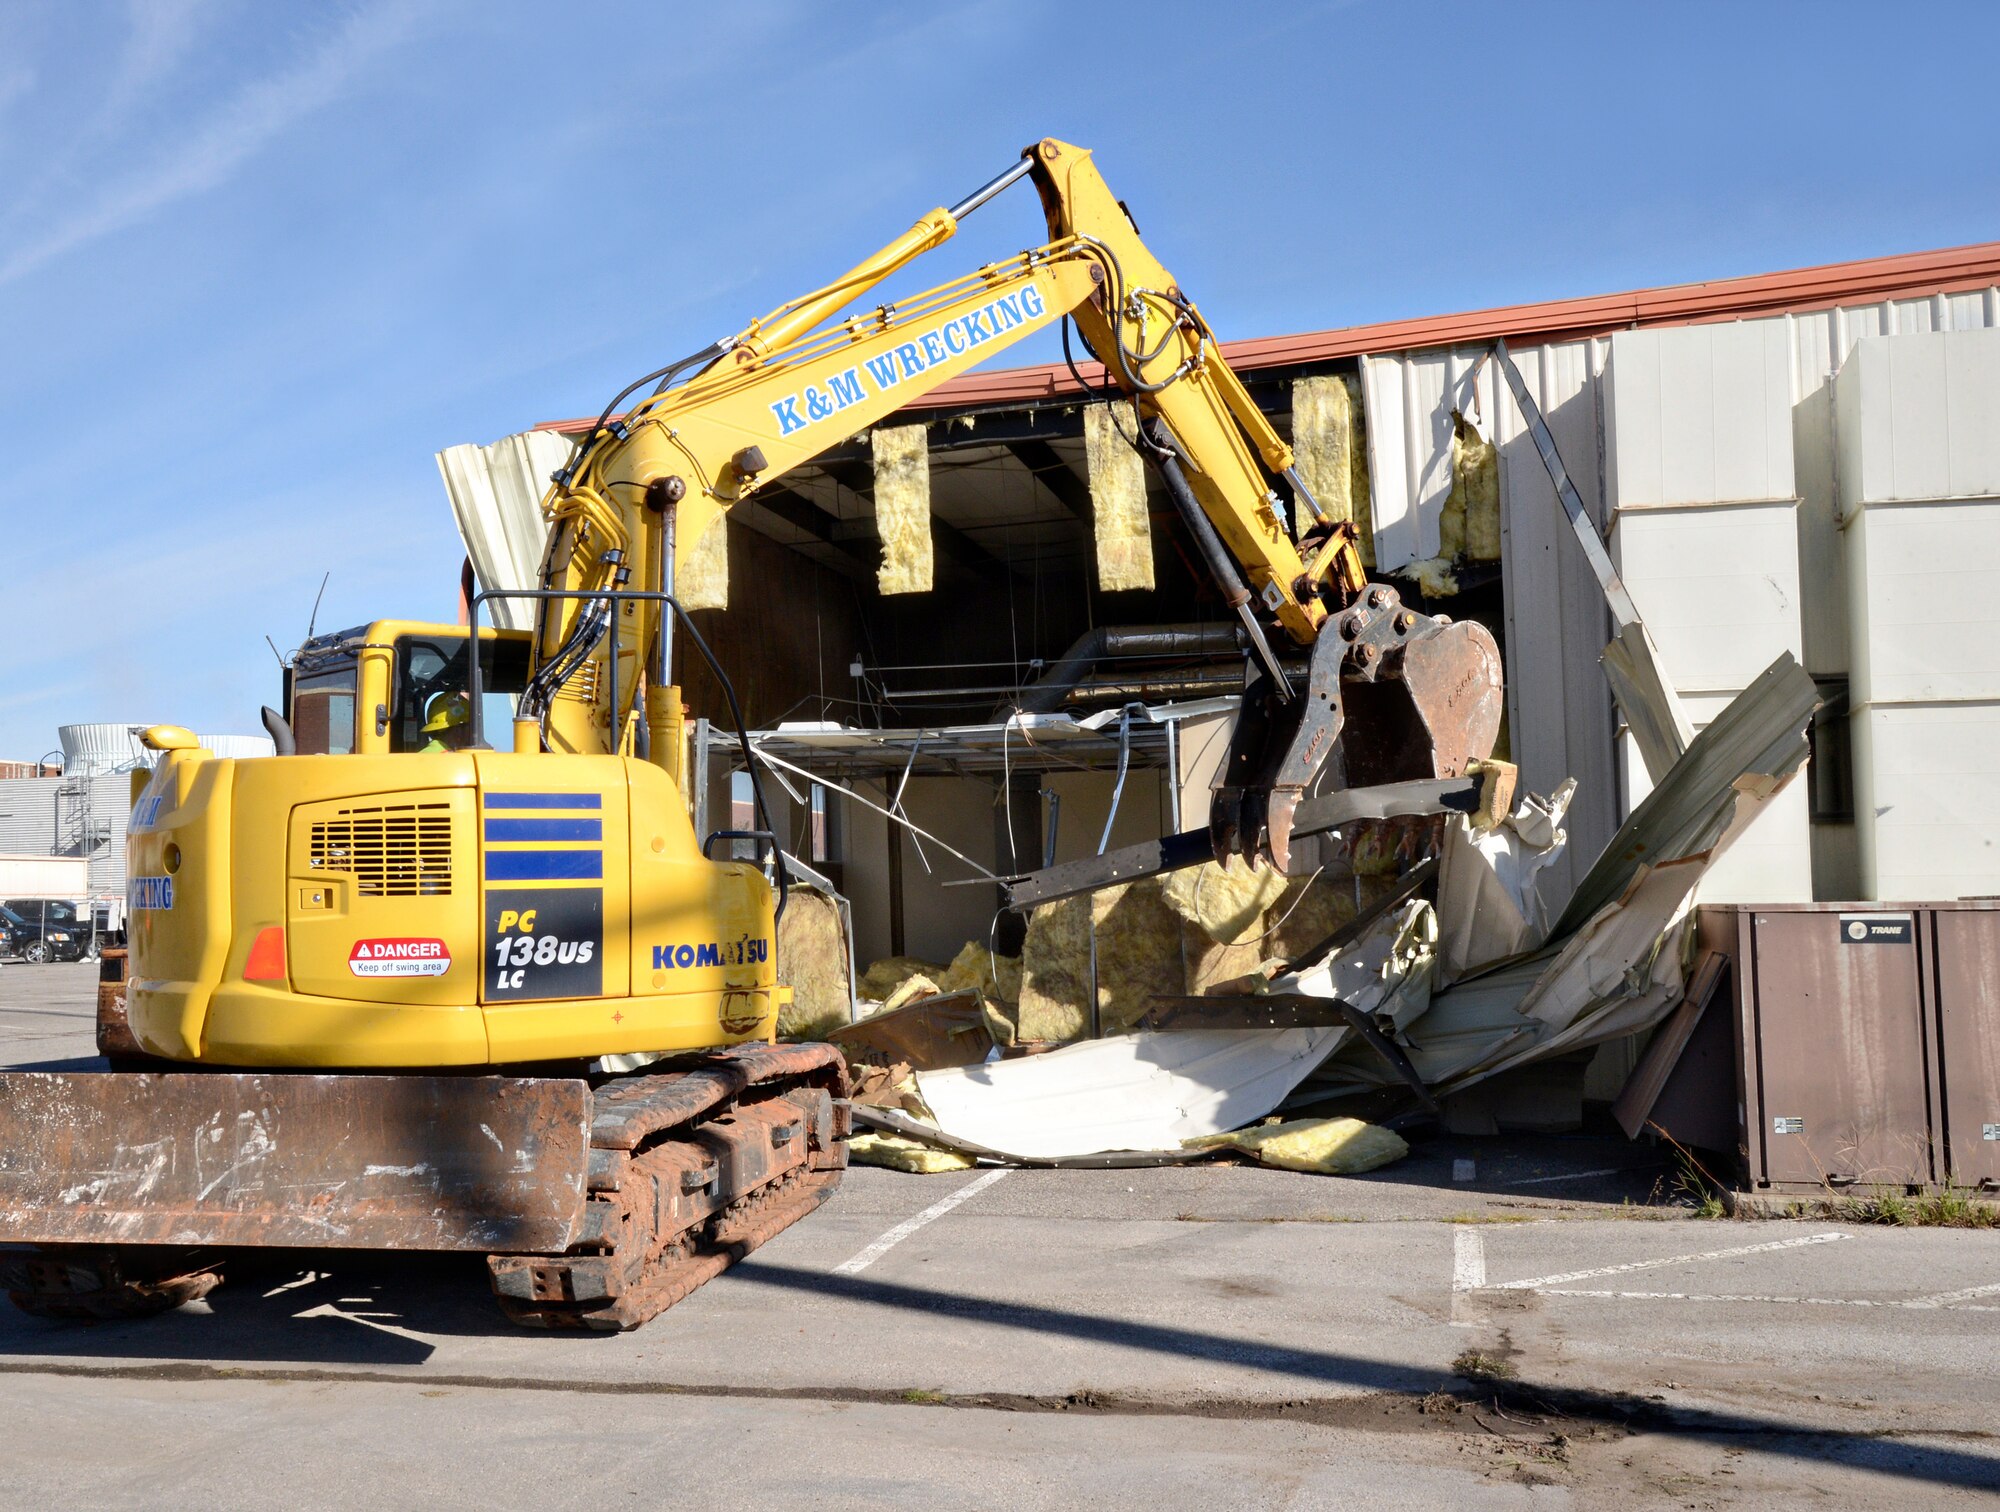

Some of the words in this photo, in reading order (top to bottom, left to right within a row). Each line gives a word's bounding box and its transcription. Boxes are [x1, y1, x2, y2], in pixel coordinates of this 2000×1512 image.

[865, 285, 1044, 389] WRECKING
[497, 909, 537, 934] PC
[1870, 926, 1903, 935] TRANE
[373, 943, 441, 957] DANGER
[358, 963, 379, 973] Keep
[382, 962, 394, 972] off
[396, 962, 420, 973] swing
[422, 963, 442, 971] area
[496, 970, 525, 990] LC
